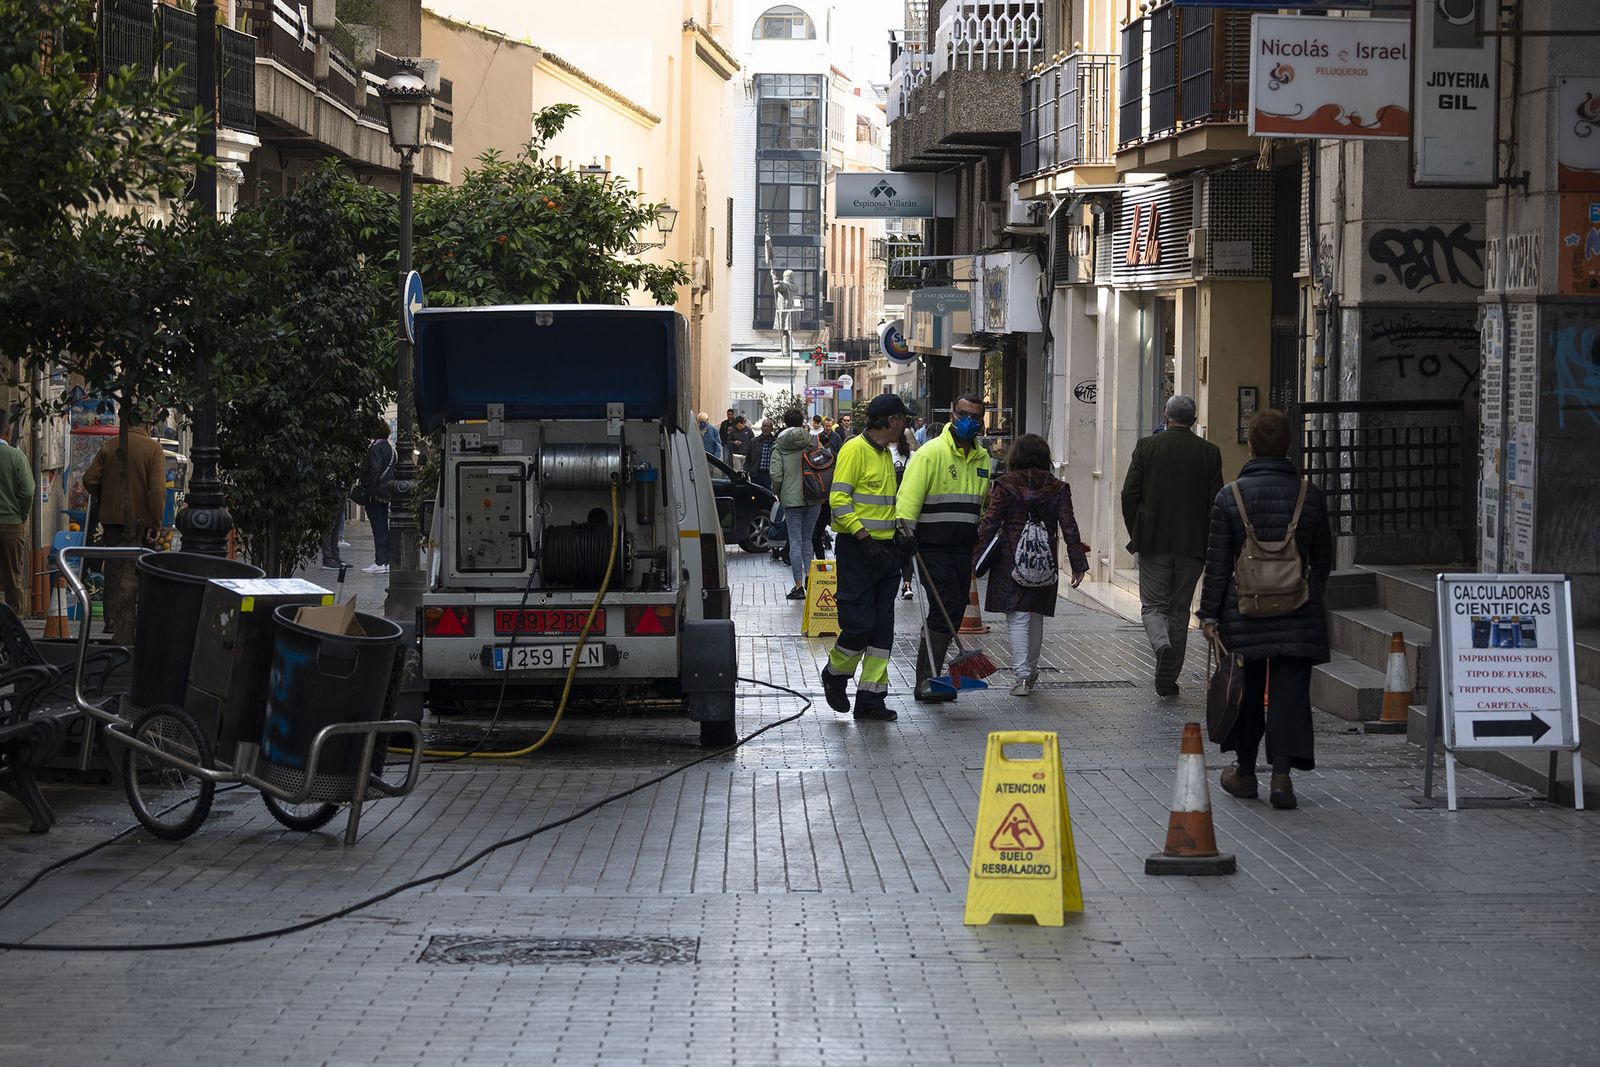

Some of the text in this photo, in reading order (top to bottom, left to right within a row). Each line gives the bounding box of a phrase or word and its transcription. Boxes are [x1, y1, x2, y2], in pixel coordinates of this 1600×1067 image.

[1260, 38, 1330, 58] Nicolás
[1355, 42, 1408, 60] Israel
[1315, 66, 1369, 77] PELUQUEROS
[1426, 71, 1490, 88] JOYERIA
[1438, 94, 1477, 110] GIL
[1485, 235, 1541, 290] FOCOPIAS
[1377, 354, 1480, 397] TOY
[1454, 585, 1550, 600] CALCULADORAS
[1455, 602, 1551, 615] CIENTIFICAS
[508, 649, 553, 667] 1259
[1459, 655, 1552, 663] IMPRIMIMOS TODO
[1466, 670, 1489, 679] TIPO
[1492, 670, 1505, 679] DE
[1458, 686, 1556, 695] TRIPTICOS, SOBRES,
[995, 783, 1046, 794] ATENCION
[999, 852, 1033, 861] SUELO
[981, 864, 1051, 875] RESBALADIZO
